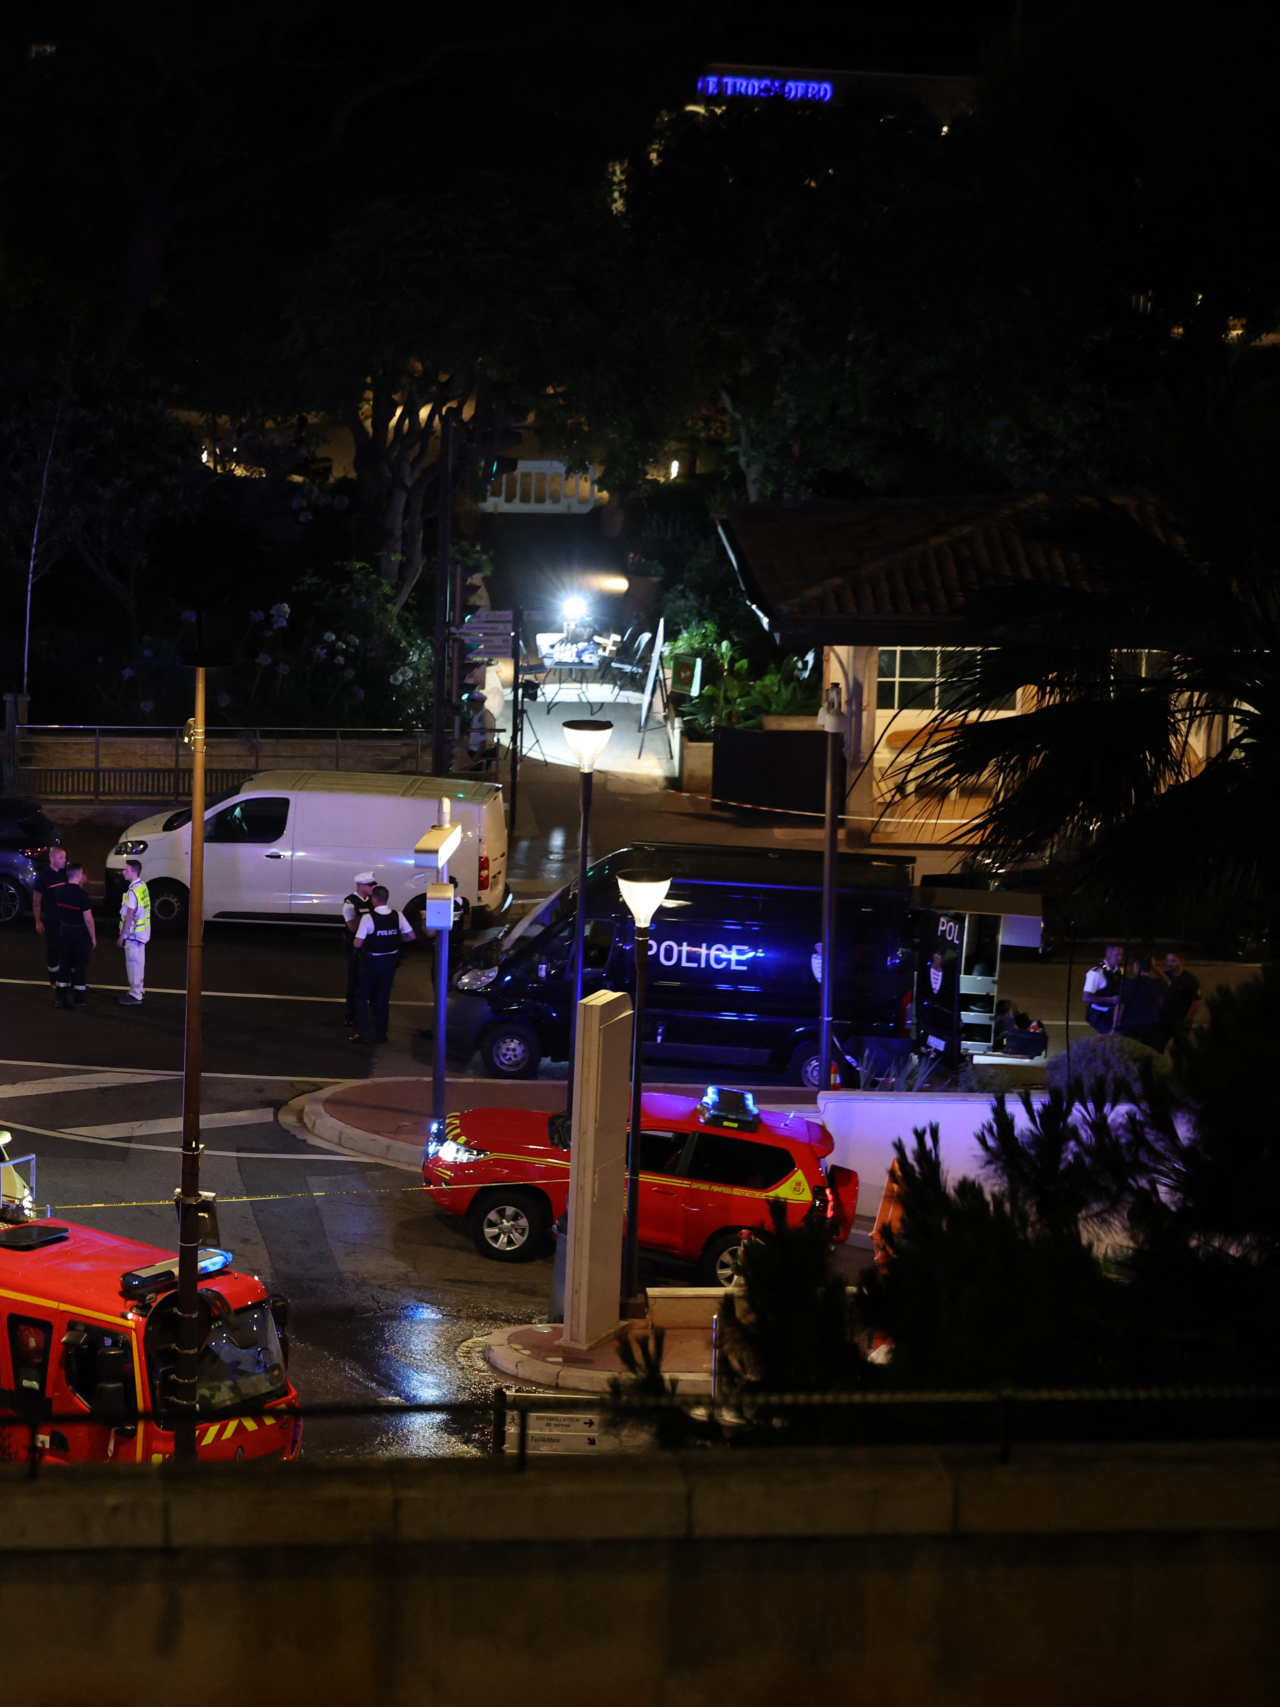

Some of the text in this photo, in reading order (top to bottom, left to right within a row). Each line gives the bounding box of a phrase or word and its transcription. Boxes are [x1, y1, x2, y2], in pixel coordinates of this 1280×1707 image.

[722, 75, 834, 102] TROCDERO
[376, 929, 398, 937] POLICE
[937, 916, 960, 945] POL
